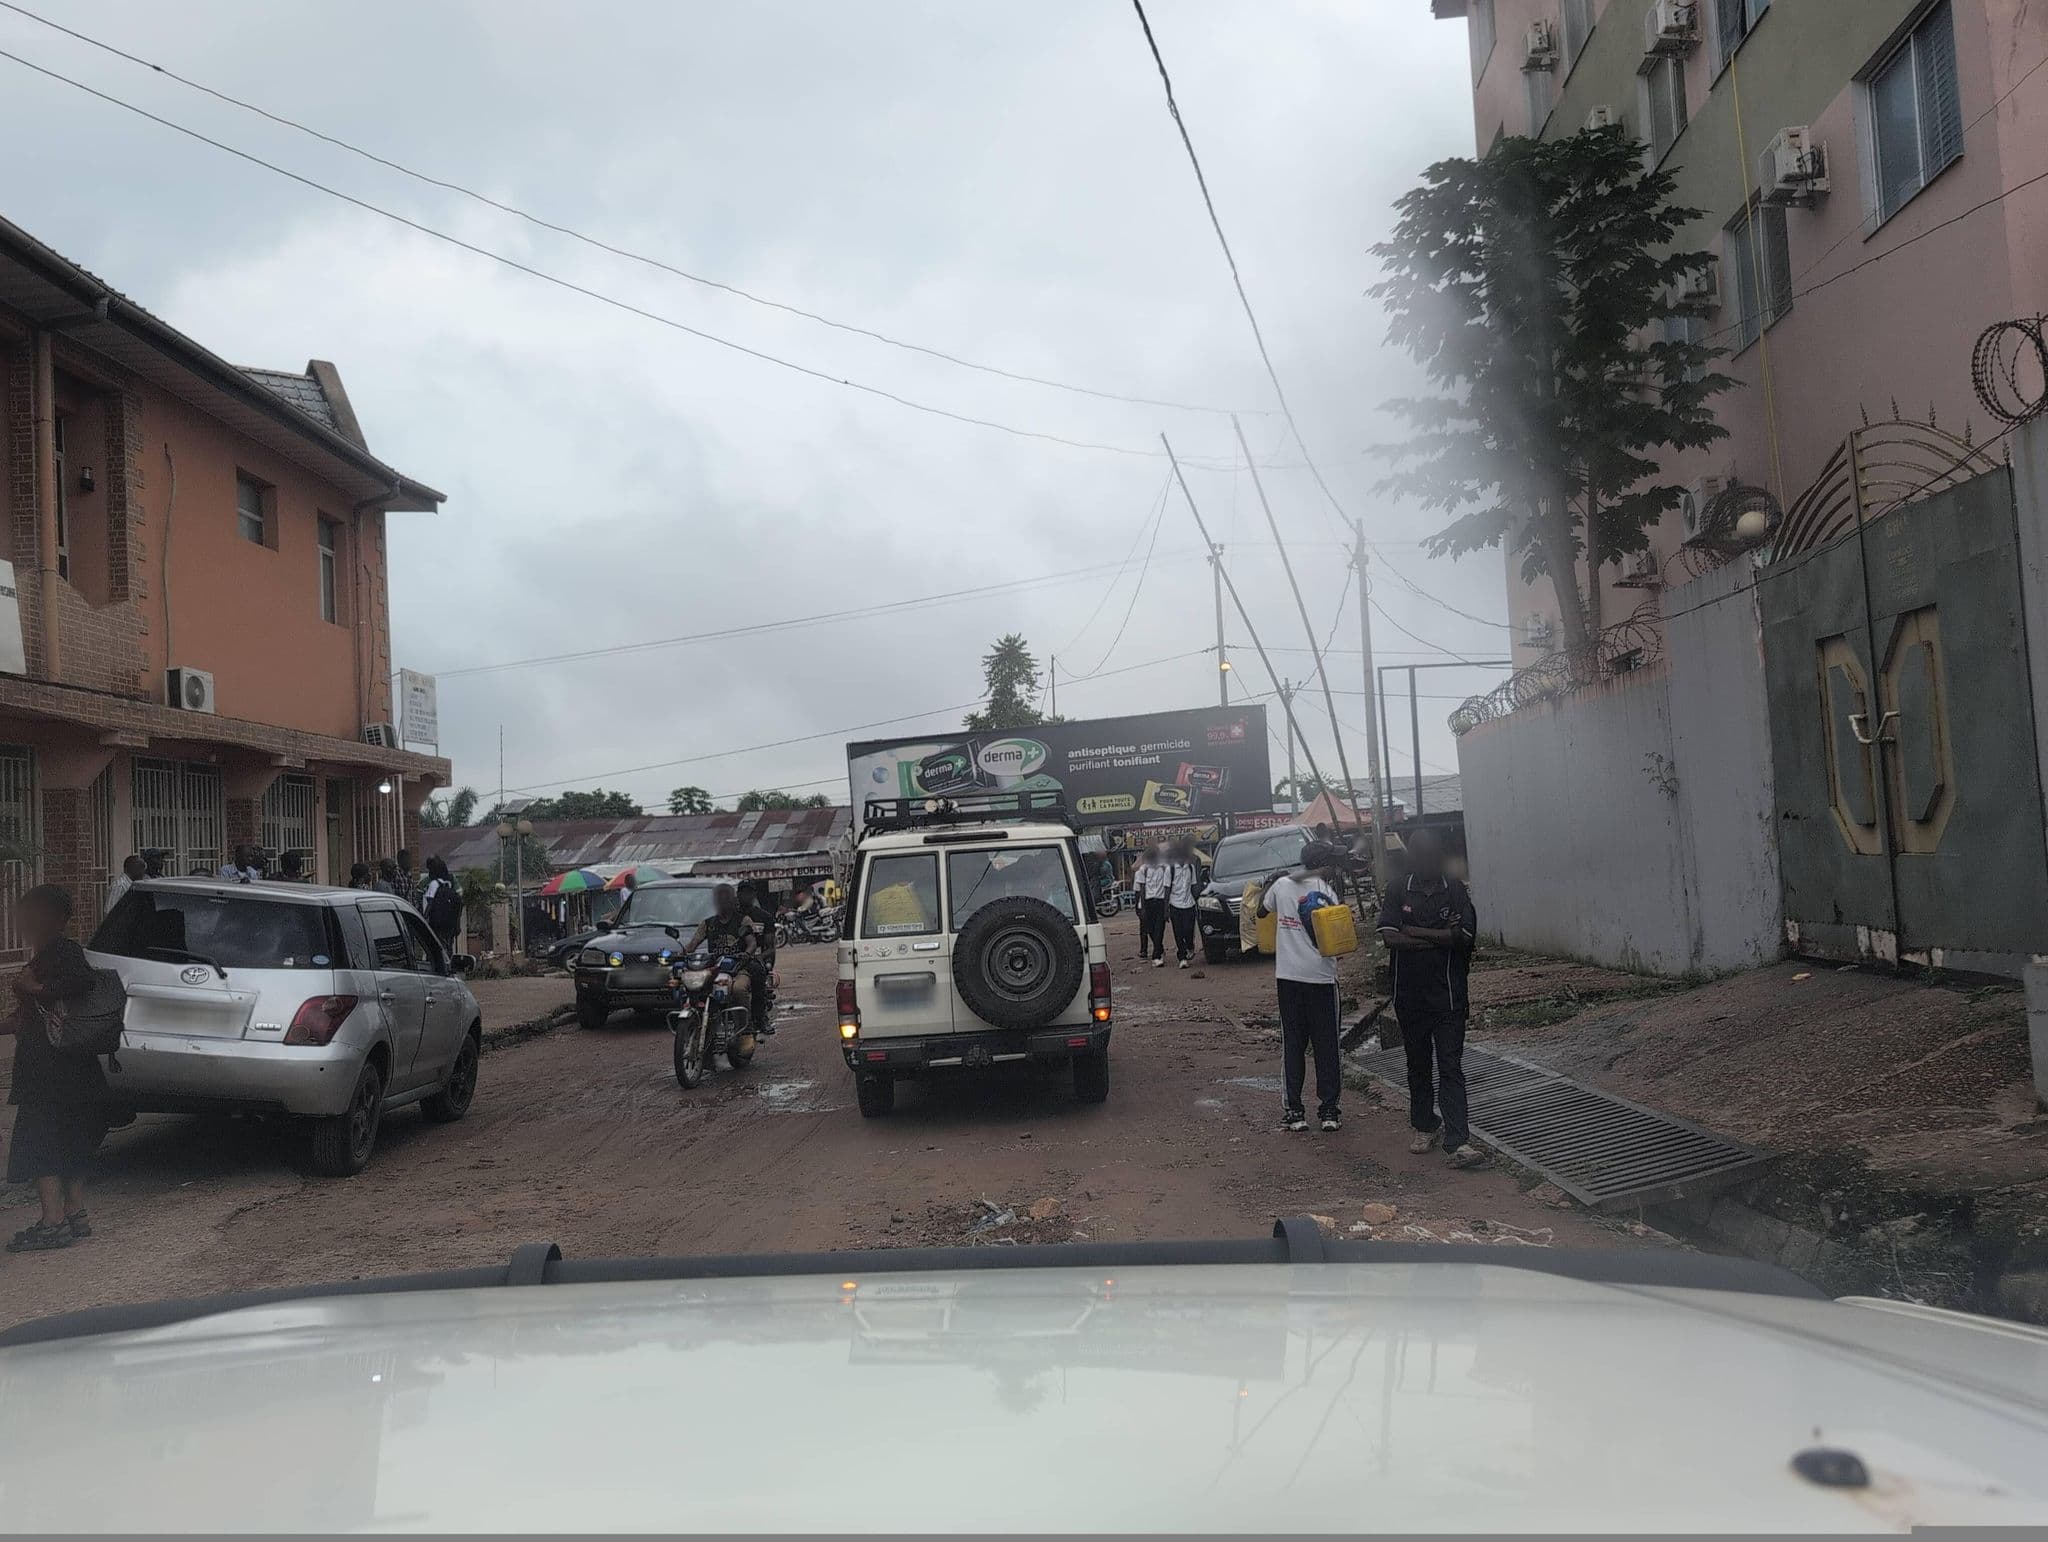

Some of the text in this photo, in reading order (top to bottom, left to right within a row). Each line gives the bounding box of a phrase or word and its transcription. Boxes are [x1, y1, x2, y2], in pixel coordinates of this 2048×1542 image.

[984, 749, 1023, 763] derma
[1068, 739, 1191, 759] antiseptique germicide
[924, 762, 953, 778] derma
[1069, 754, 1161, 773] purifiant tonifiant
[797, 866, 815, 876] BON
[817, 865, 833, 874] PRI
